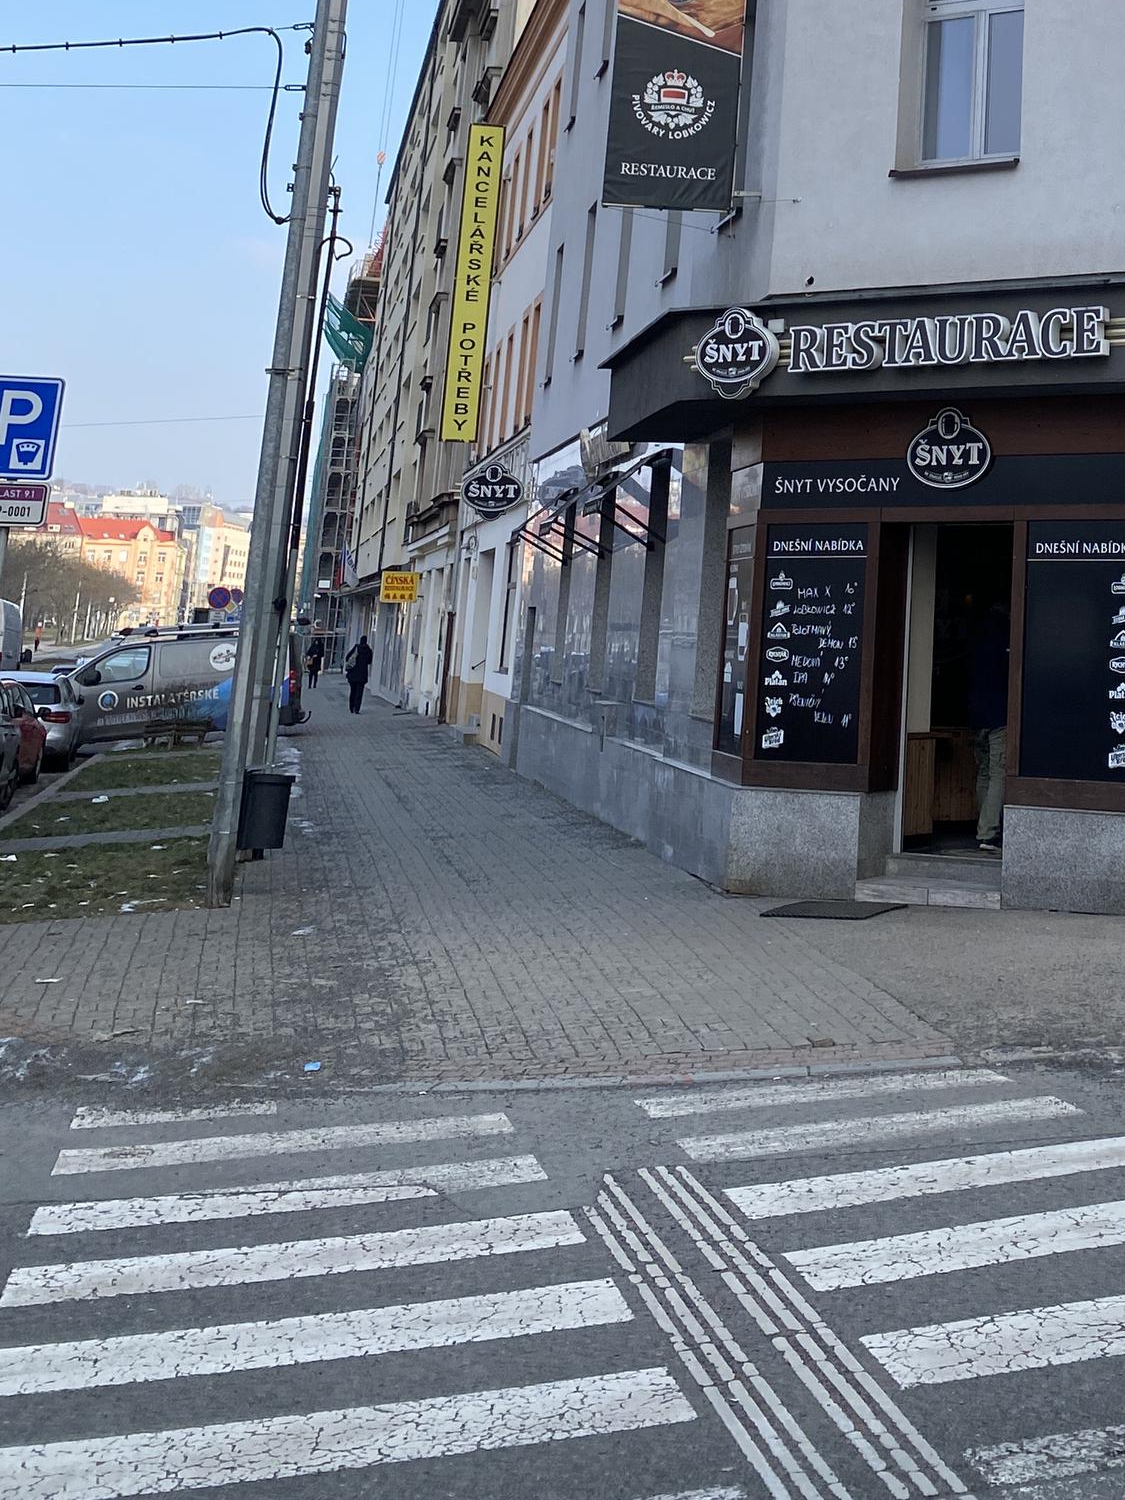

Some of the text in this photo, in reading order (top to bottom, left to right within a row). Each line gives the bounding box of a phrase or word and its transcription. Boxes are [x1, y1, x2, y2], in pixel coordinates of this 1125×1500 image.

[631, 94, 716, 139] PIVOVARY LOBKOWICZ
[620, 162, 717, 180] RESTAURACE
[453, 135, 495, 431] KANCELÁŘSKÉ POTŘEBY
[703, 305, 1109, 373] ŠNYT RESTAURACE
[0, 389, 43, 446] P
[914, 438, 983, 467] ŠNYT
[467, 480, 519, 499] ŠNYT
[774, 474, 900, 494] ŠNYT VYSOČANY
[773, 537, 864, 551] DNEŠNÍ NABÍDKA
[1035, 540, 1081, 554] DNEŠNÍ
